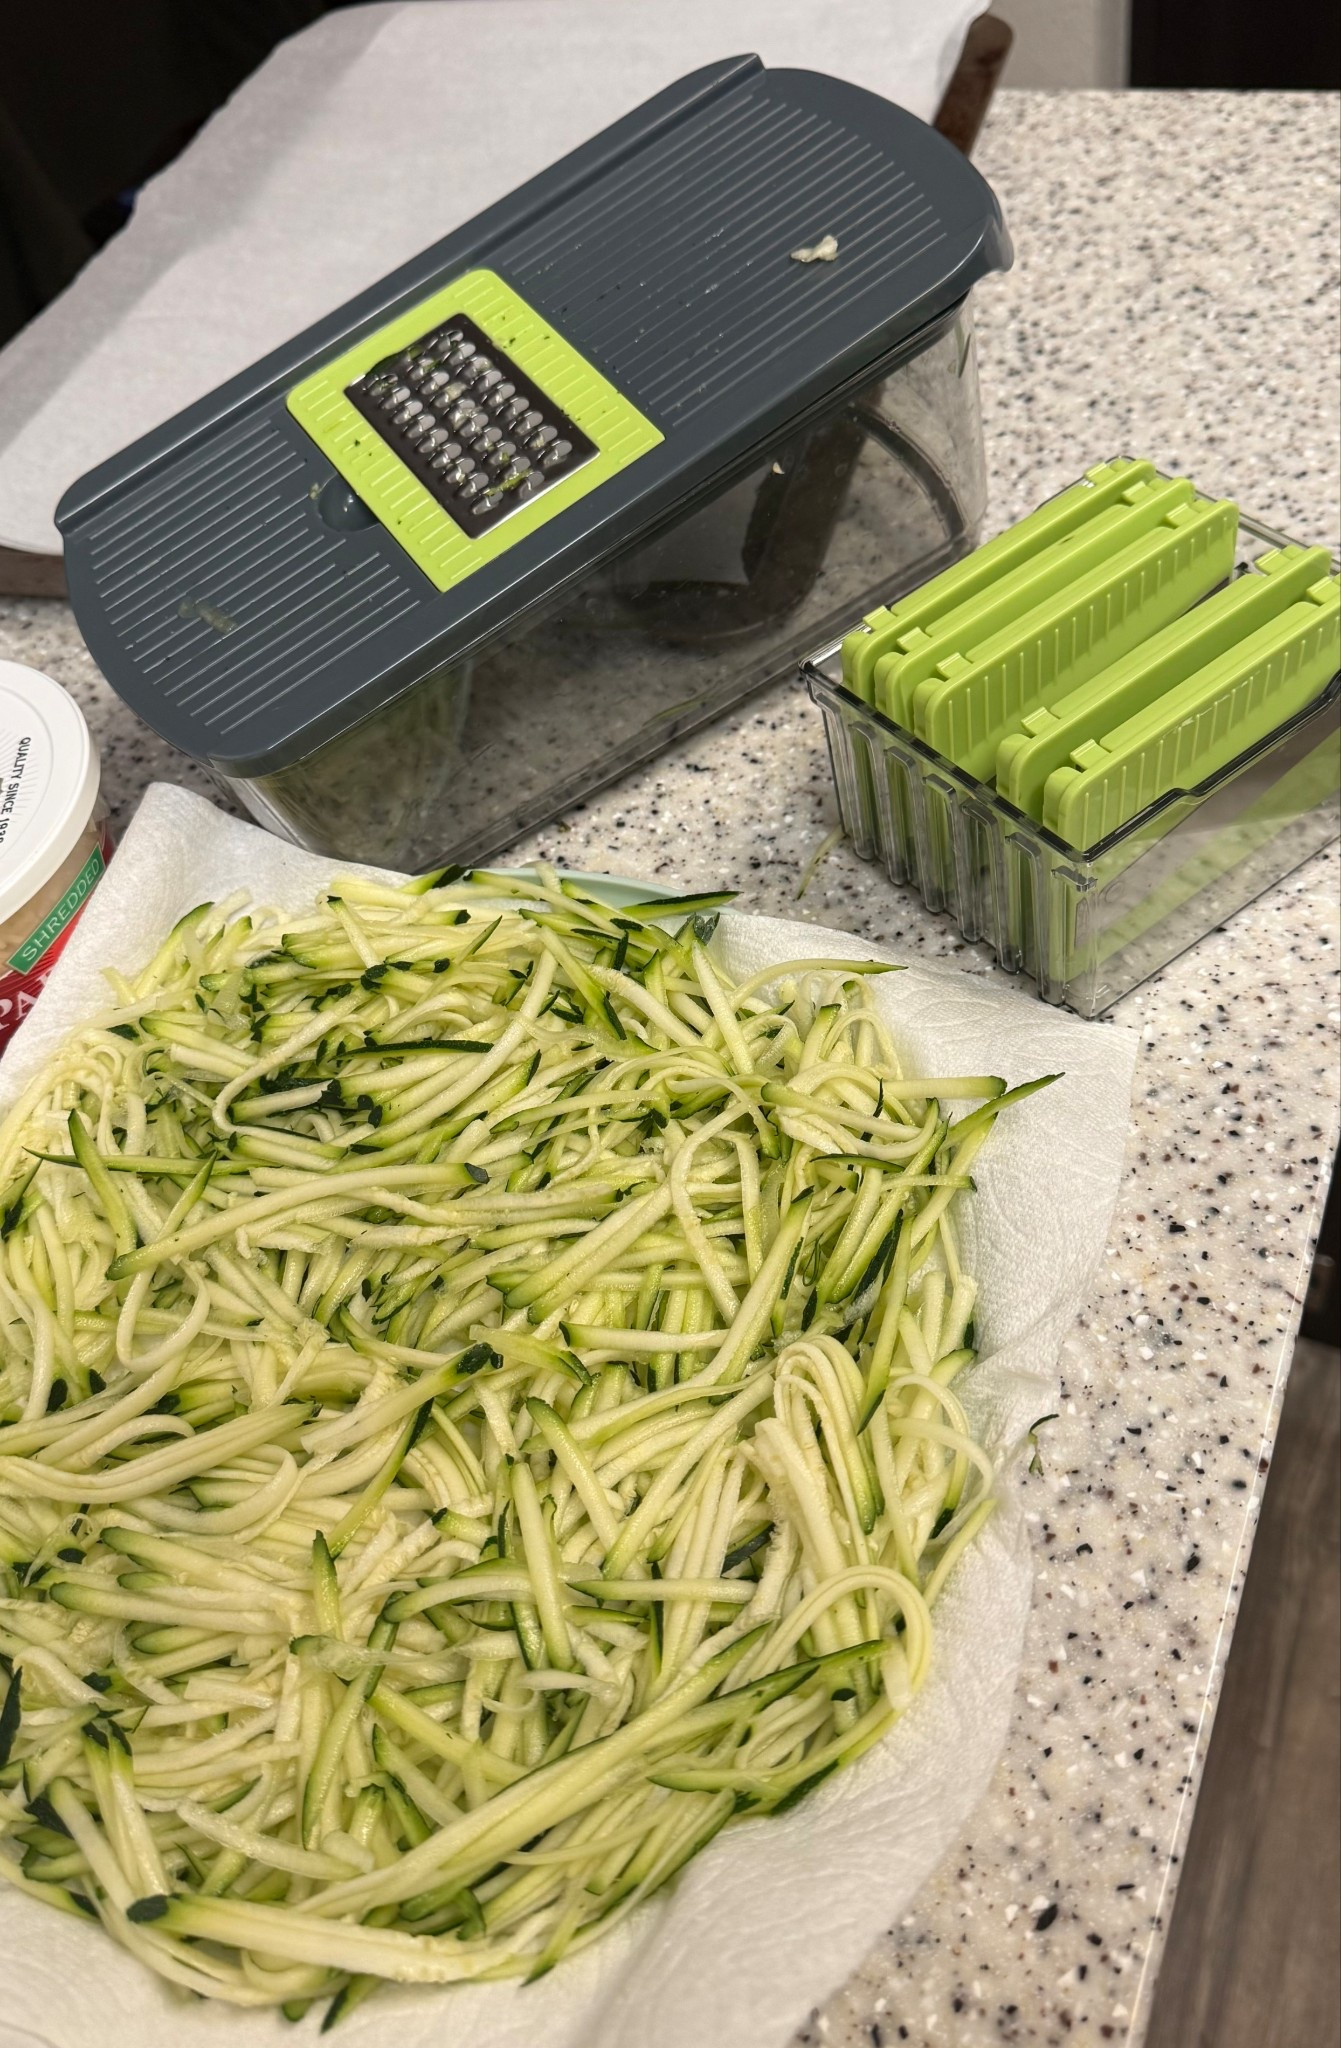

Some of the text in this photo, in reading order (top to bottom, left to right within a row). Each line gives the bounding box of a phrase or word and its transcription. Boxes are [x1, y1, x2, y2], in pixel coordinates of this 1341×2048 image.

[11, 737, 31, 779] QUALITY
[1, 783, 19, 815] SINCE
[22, 858, 99, 961] SHREDDED
